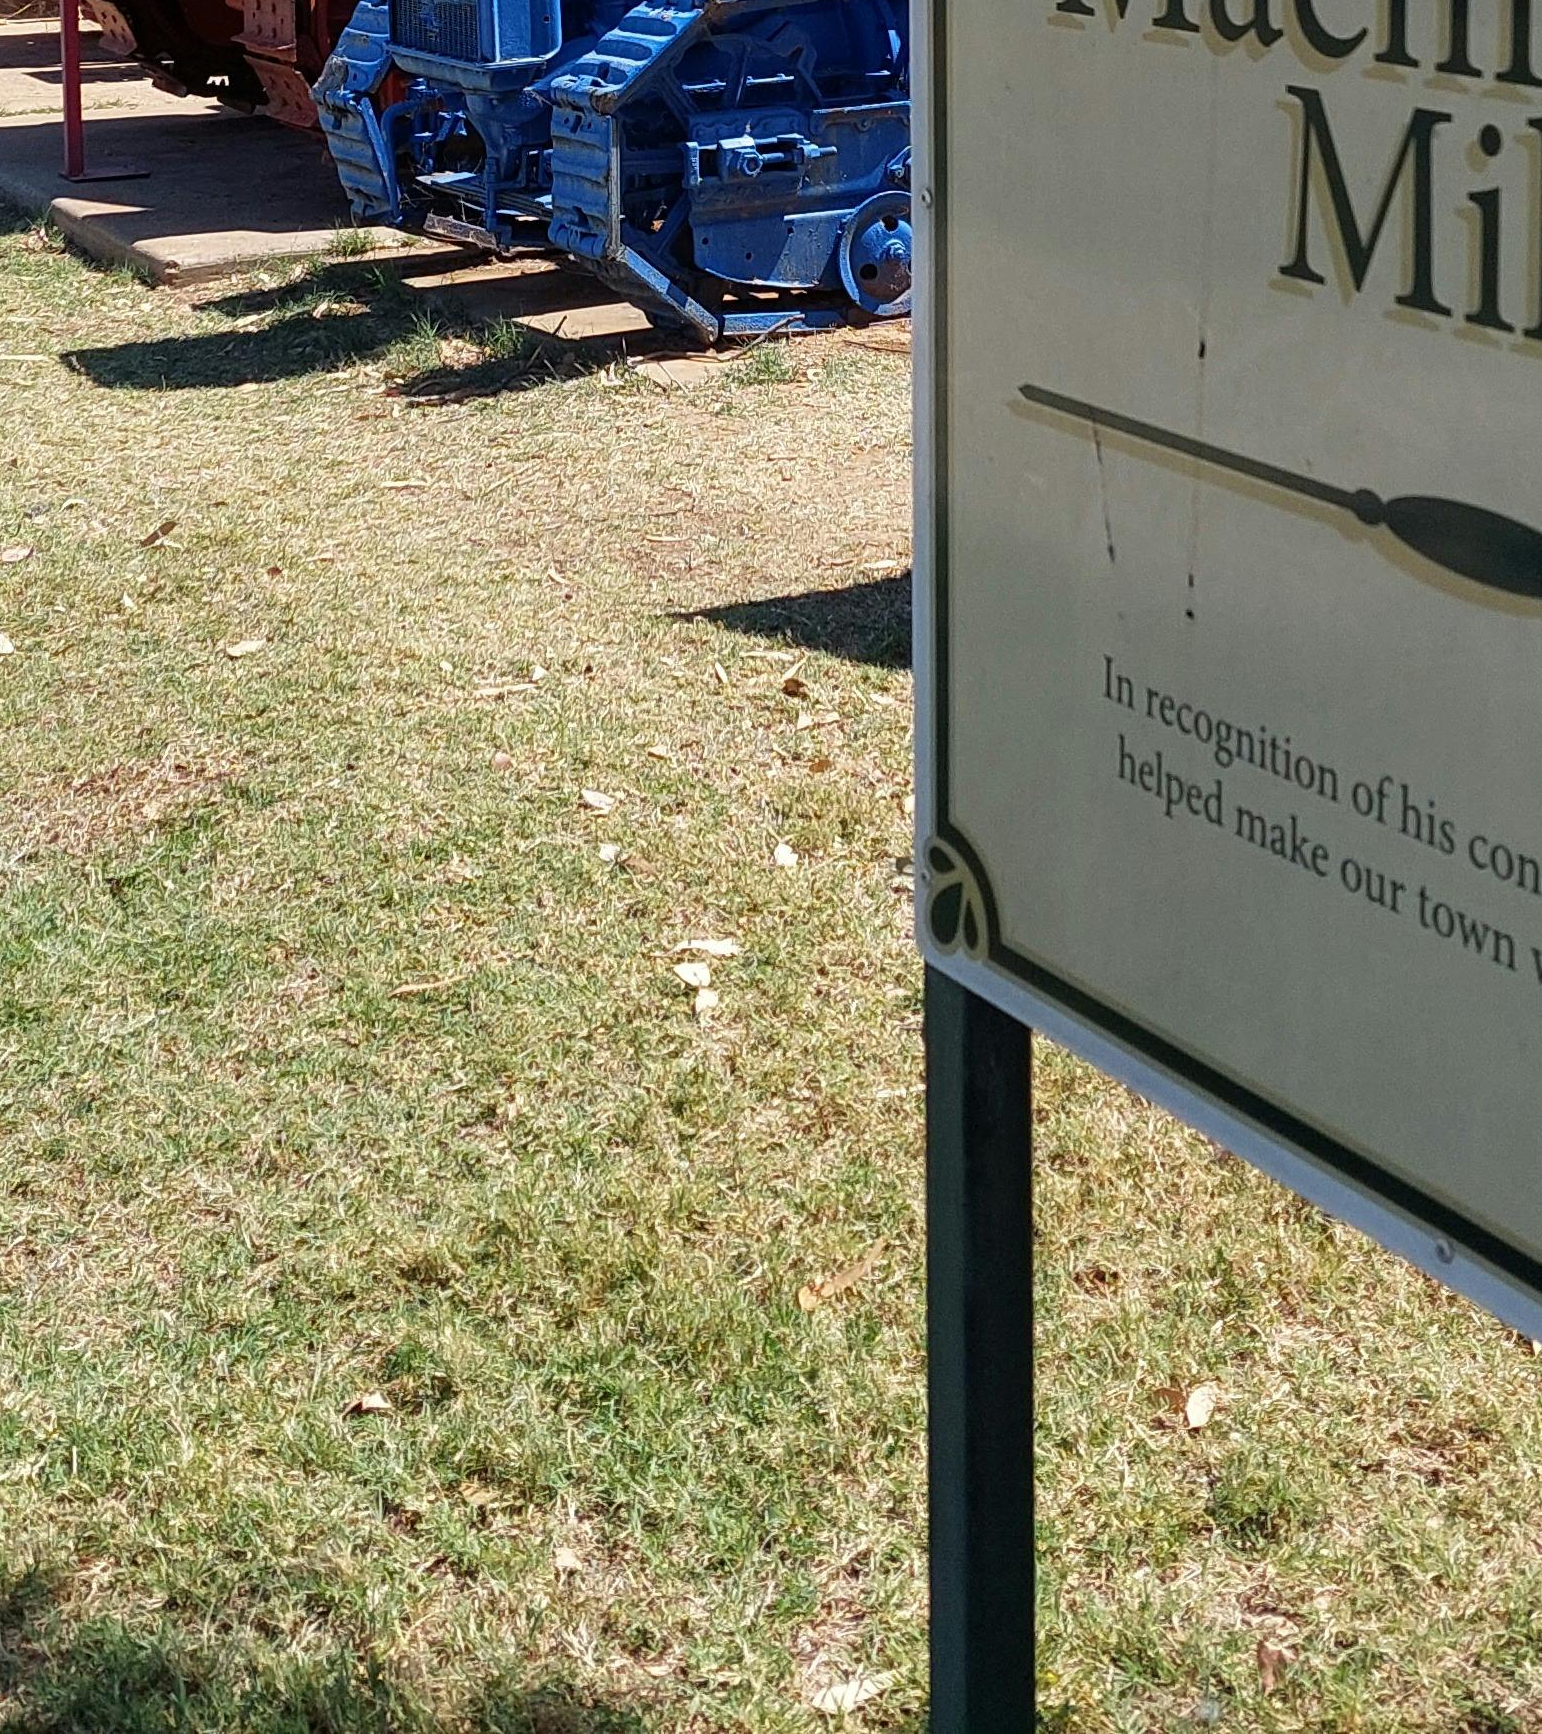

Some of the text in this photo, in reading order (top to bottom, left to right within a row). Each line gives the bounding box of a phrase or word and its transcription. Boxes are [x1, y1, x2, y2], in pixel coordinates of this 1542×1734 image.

[1101, 654, 1136, 711] In
[1144, 686, 1340, 805] recognition
[1350, 774, 1396, 826] of
[1397, 782, 1457, 856] his
[1116, 732, 1226, 829] helped
[1234, 805, 1332, 880] make
[1338, 857, 1409, 916] our
[1417, 885, 1518, 973] town
